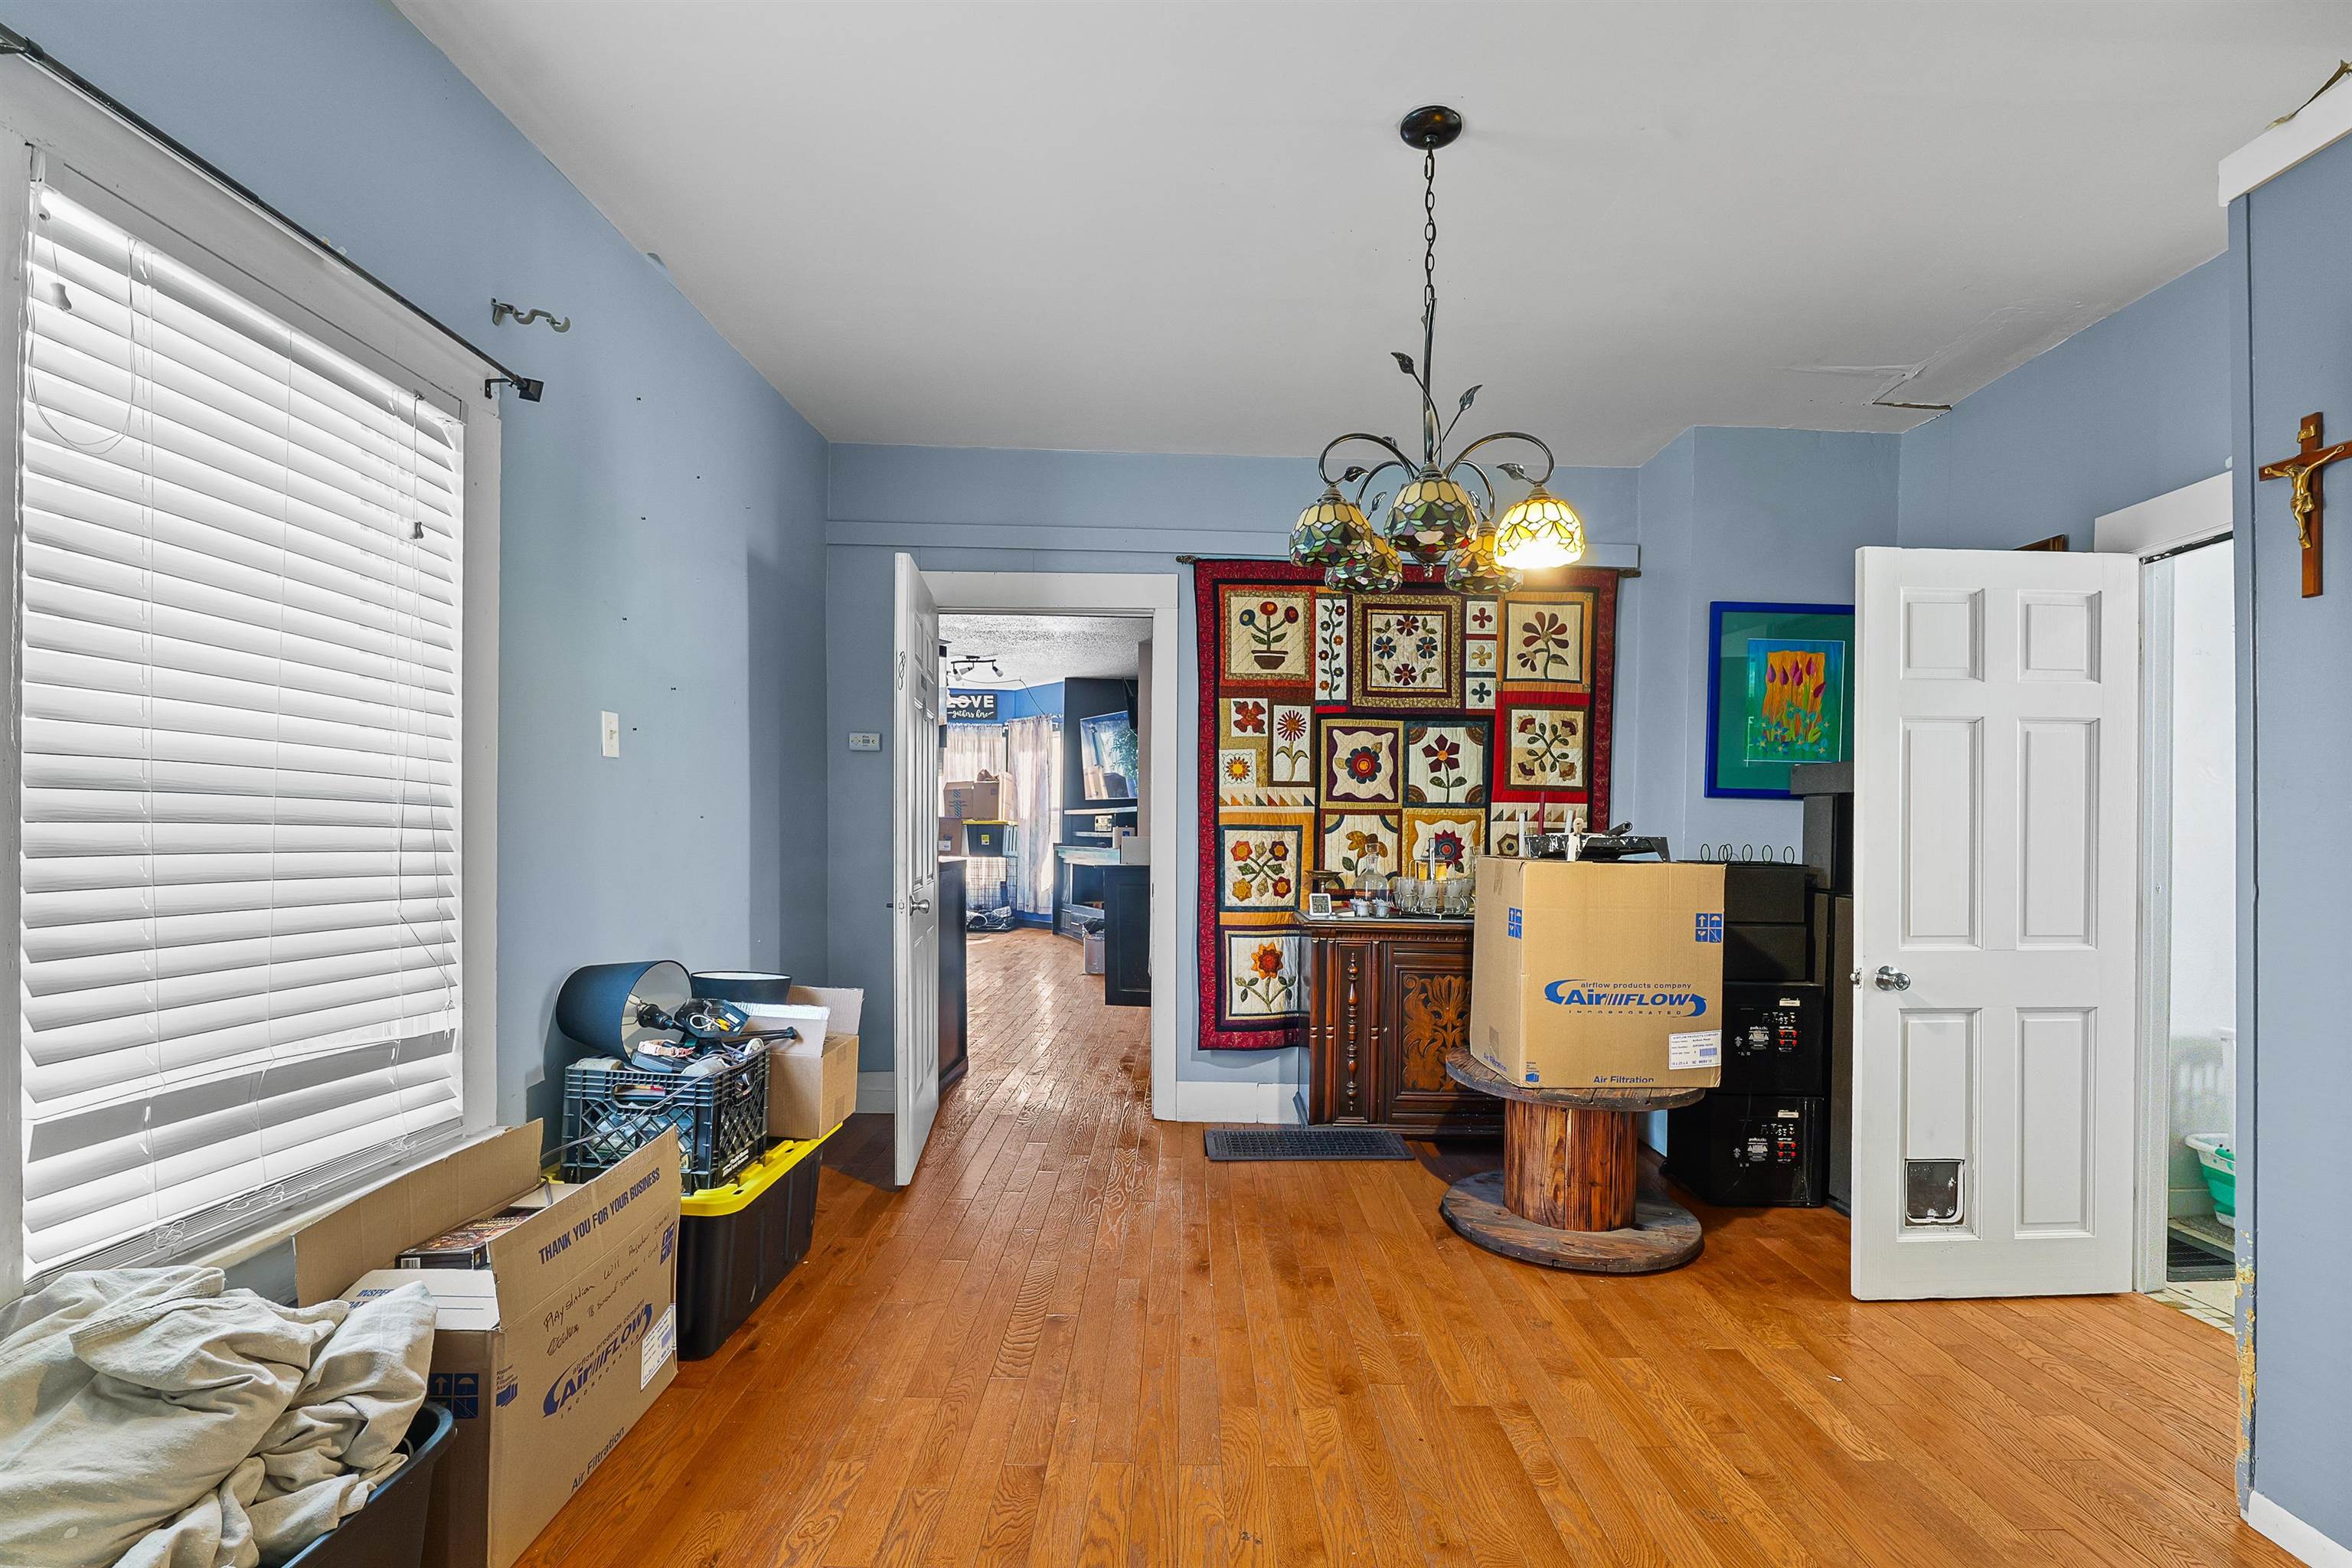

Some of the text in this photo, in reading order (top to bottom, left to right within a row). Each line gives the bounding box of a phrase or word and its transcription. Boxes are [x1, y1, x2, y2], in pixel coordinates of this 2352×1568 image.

[538, 1167, 660, 1264] THANK YOU FOR YOUR BUSINESS
[573, 1298, 645, 1374] airflow products company
[571, 1427, 624, 1494] Air Filtration
